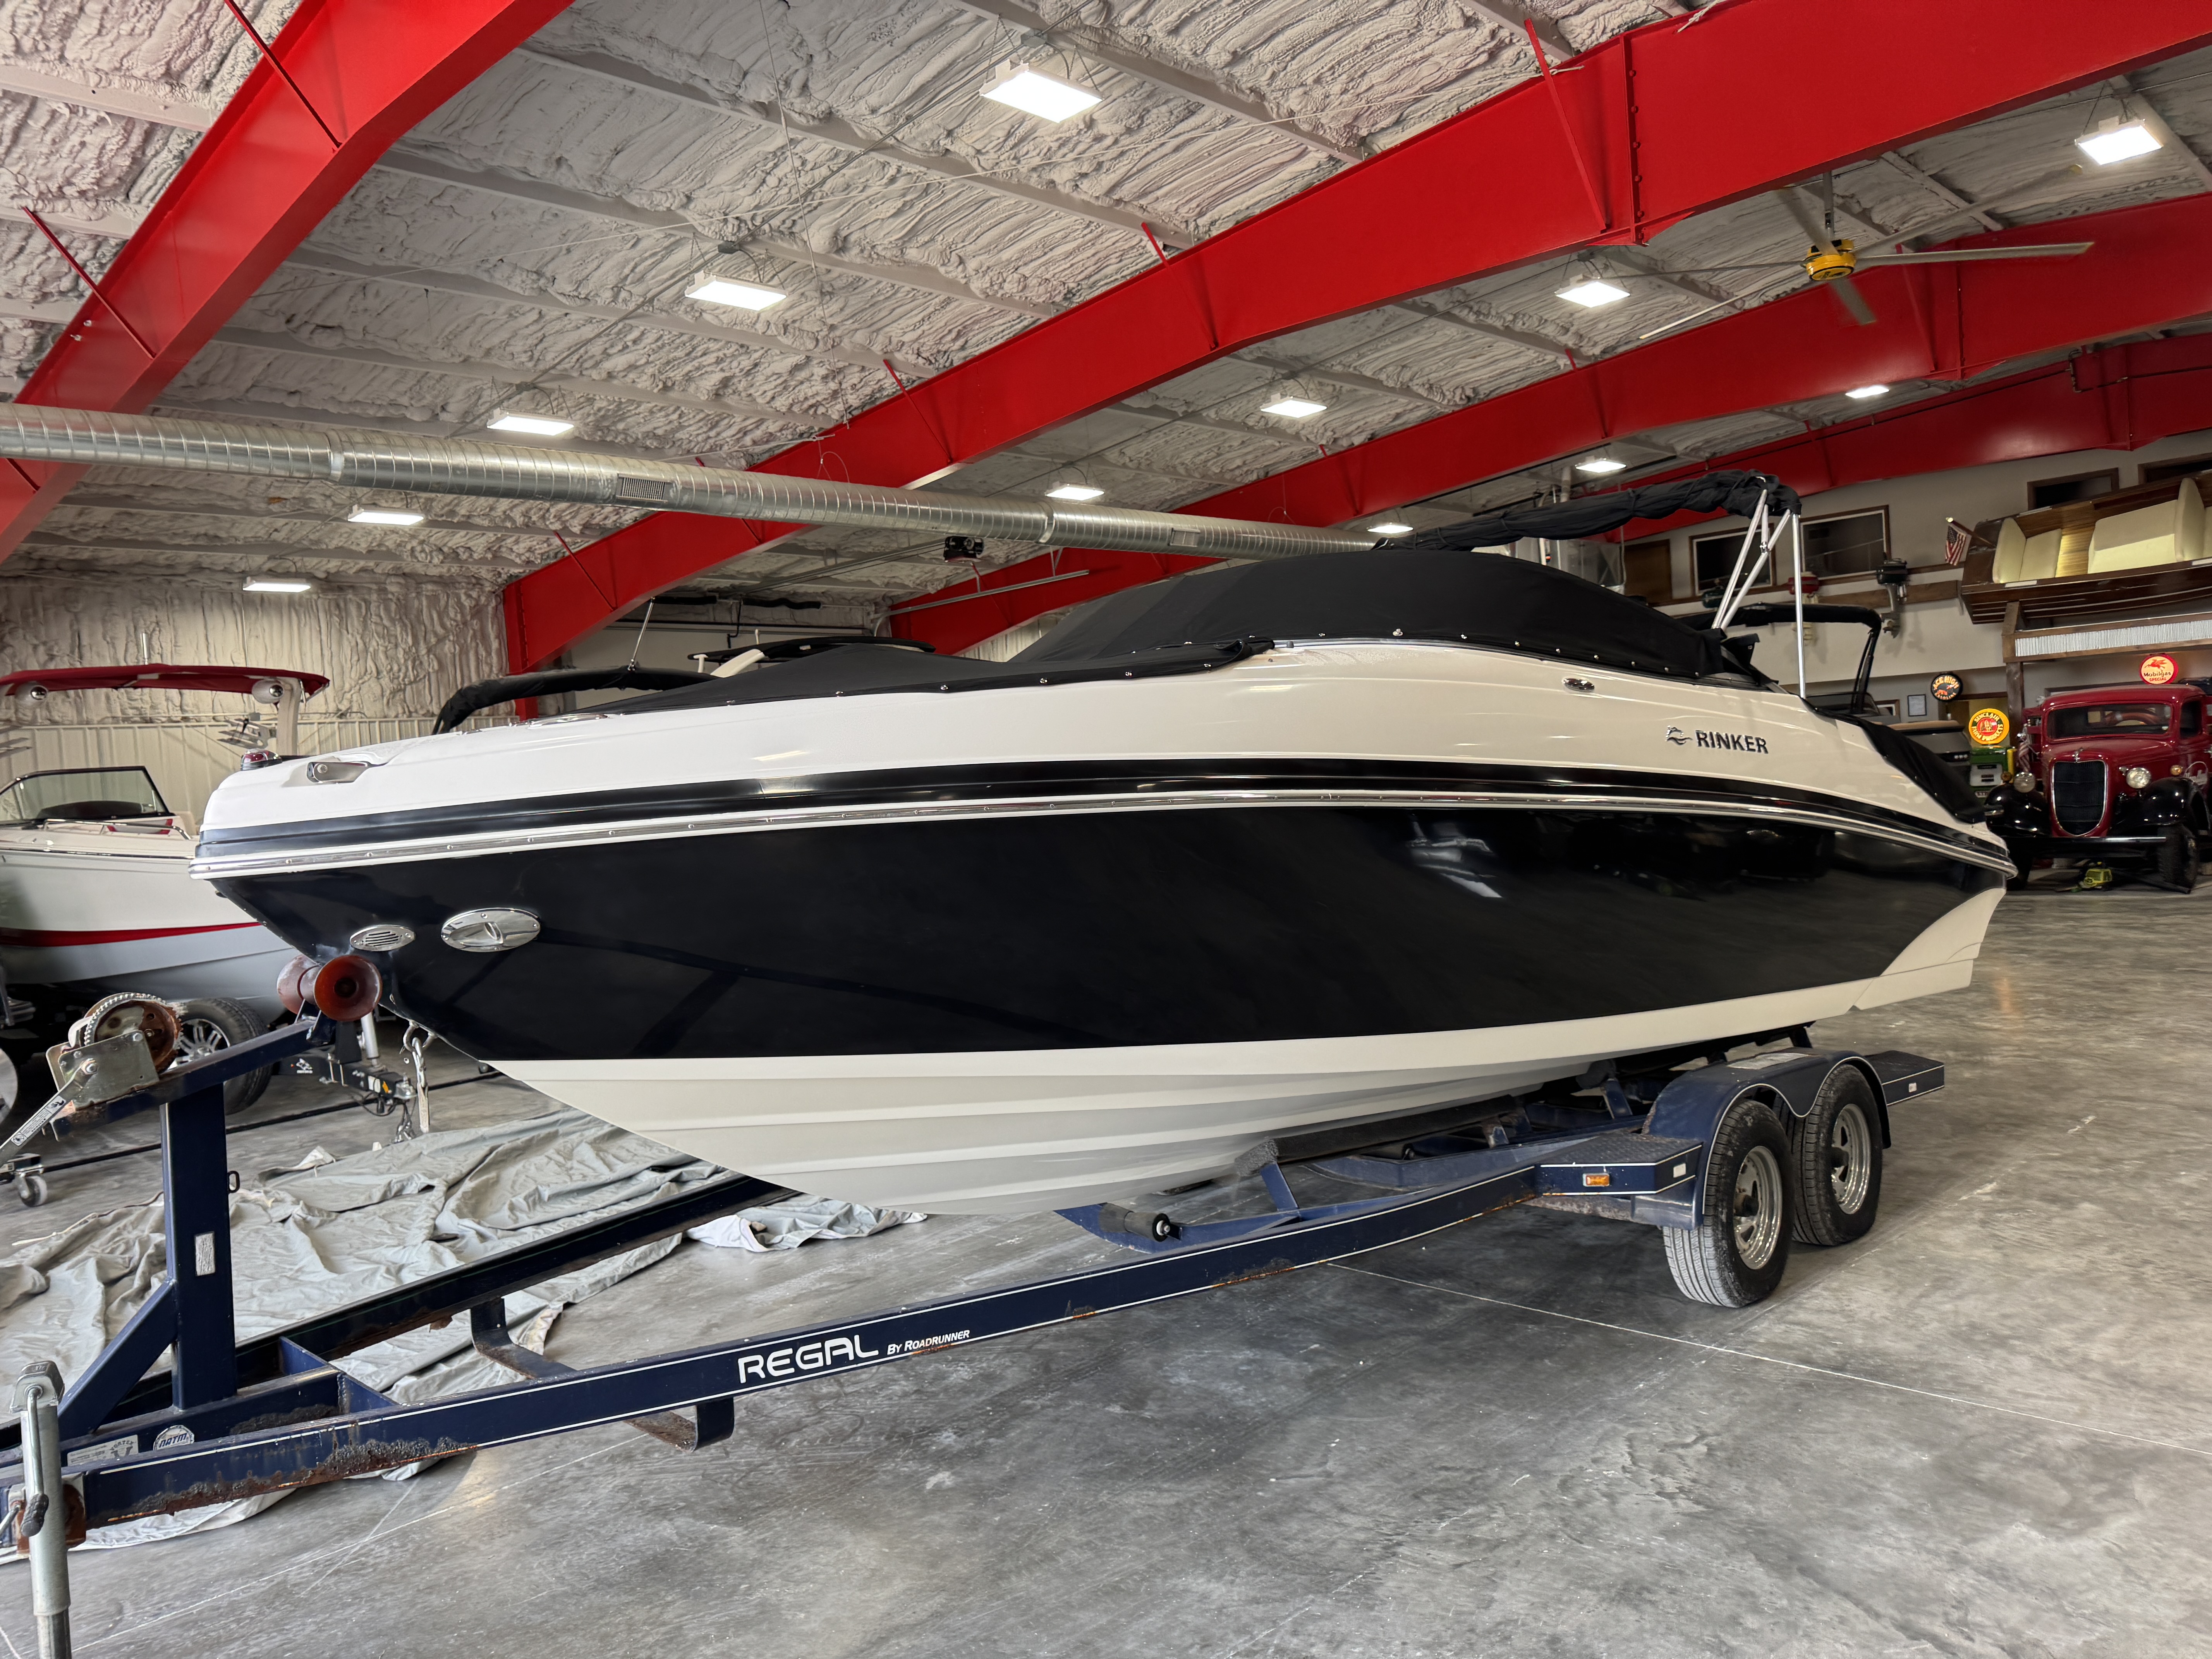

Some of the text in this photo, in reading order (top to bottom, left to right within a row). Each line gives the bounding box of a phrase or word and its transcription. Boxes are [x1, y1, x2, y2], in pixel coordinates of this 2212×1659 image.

[1933, 676, 1959, 690] ACE HIGH
[1974, 712, 2000, 723] SINCLAIR
[1972, 724, 2003, 741] FARM PRODUCTS
[1695, 730, 1769, 754] RINKER
[738, 1334, 879, 1384] REGAL
[904, 1330, 970, 1352] ROADRUNNER
[110, 1440, 134, 1451] VORTEX
